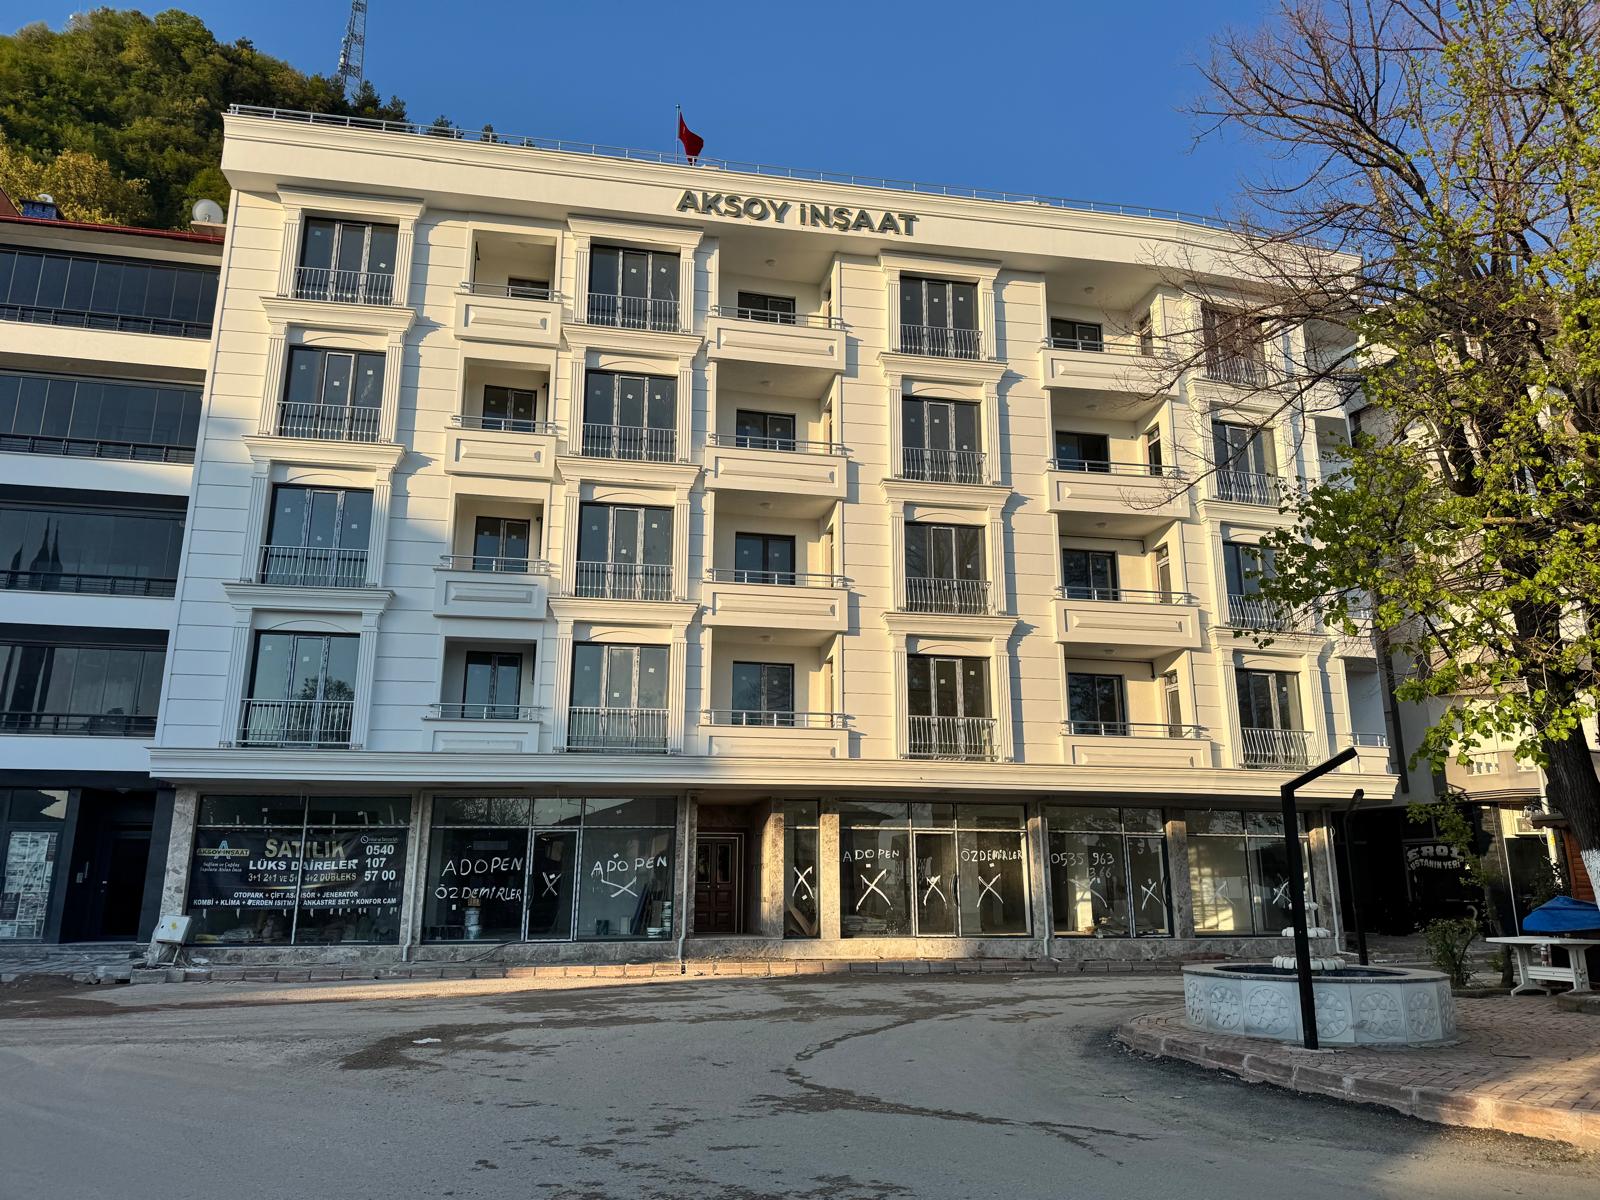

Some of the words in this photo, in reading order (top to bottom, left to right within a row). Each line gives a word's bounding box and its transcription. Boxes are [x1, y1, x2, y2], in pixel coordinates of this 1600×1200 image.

[676, 190, 791, 223] AKSOY
[264, 839, 345, 858] SATILIK
[366, 845, 394, 855] 0540
[249, 859, 286, 871] LÜKS
[365, 857, 386, 868] 107
[1050, 852, 1085, 867] 0535
[1092, 852, 1115, 866] 963
[441, 857, 523, 877] ADOPEN
[248, 873, 261, 882] 3+1
[263, 873, 277, 882] 2+1
[364, 870, 379, 881] 57
[381, 870, 396, 881] 00
[234, 891, 264, 899] OTOPARK
[383, 897, 397, 905] CAM
